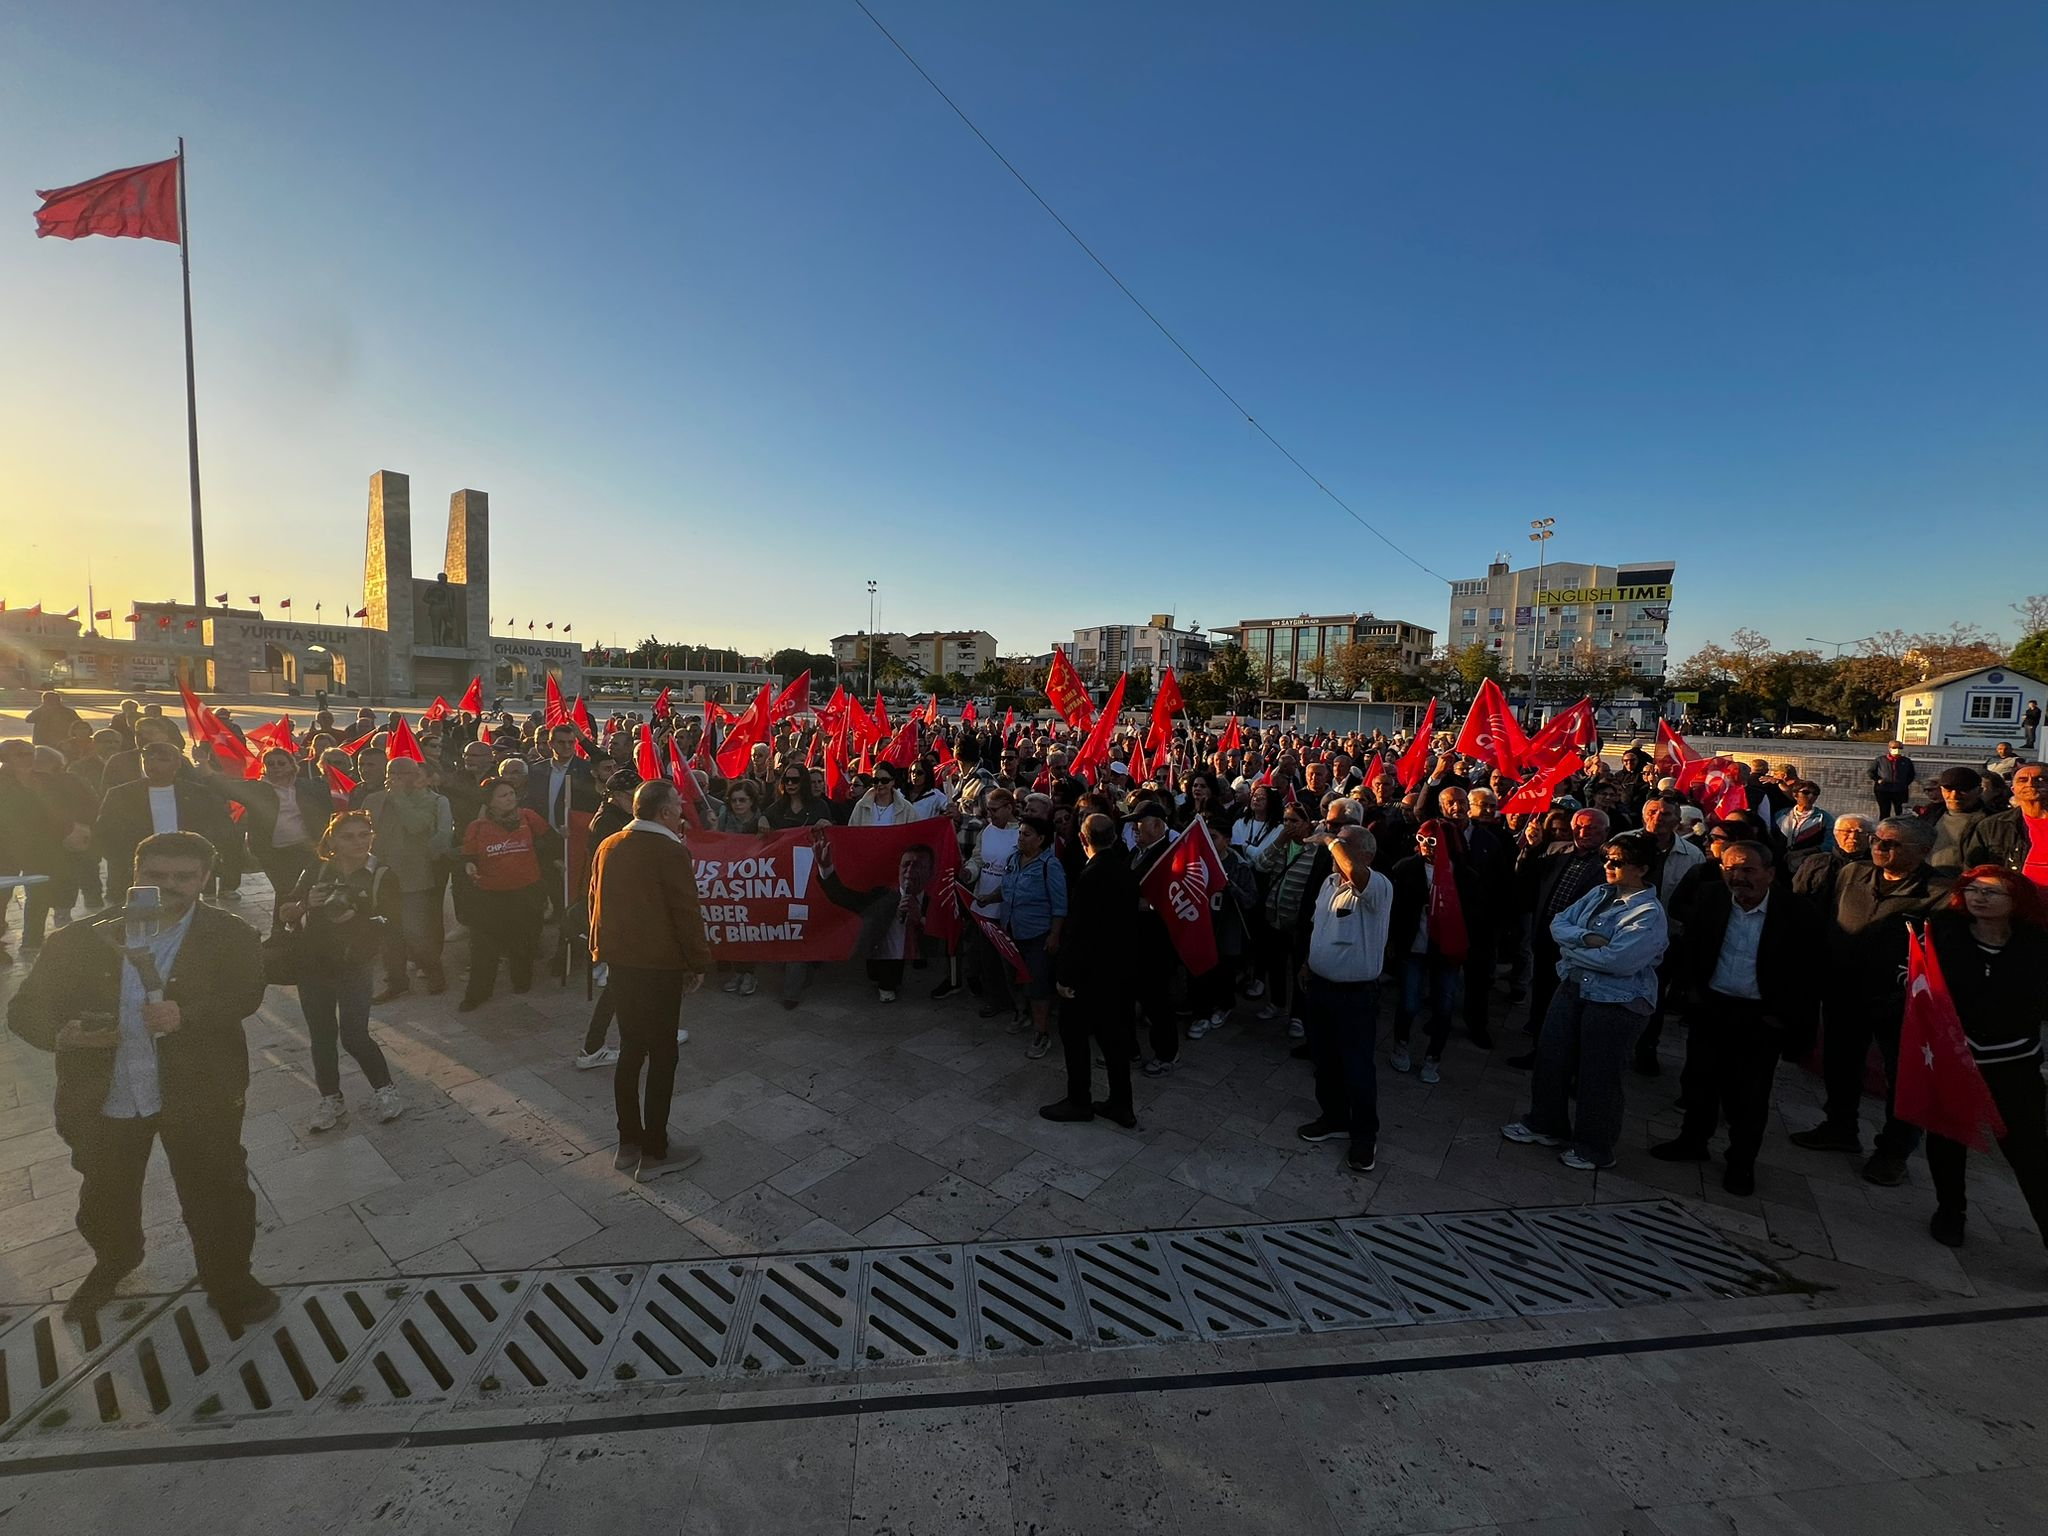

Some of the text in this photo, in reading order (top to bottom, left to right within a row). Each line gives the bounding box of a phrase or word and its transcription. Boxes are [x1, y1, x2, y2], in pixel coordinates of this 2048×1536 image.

[1538, 586, 1667, 603] ENGLISH TIME
[240, 625, 348, 643] YURTTA SULH
[545, 647, 572, 659] SULH
[726, 857, 777, 879] YOK
[696, 878, 792, 901] BAŞINA
[1168, 881, 1200, 922] CHP
[701, 904, 748, 923] ABER
[704, 922, 804, 944] İÇ BİRİMİZ
